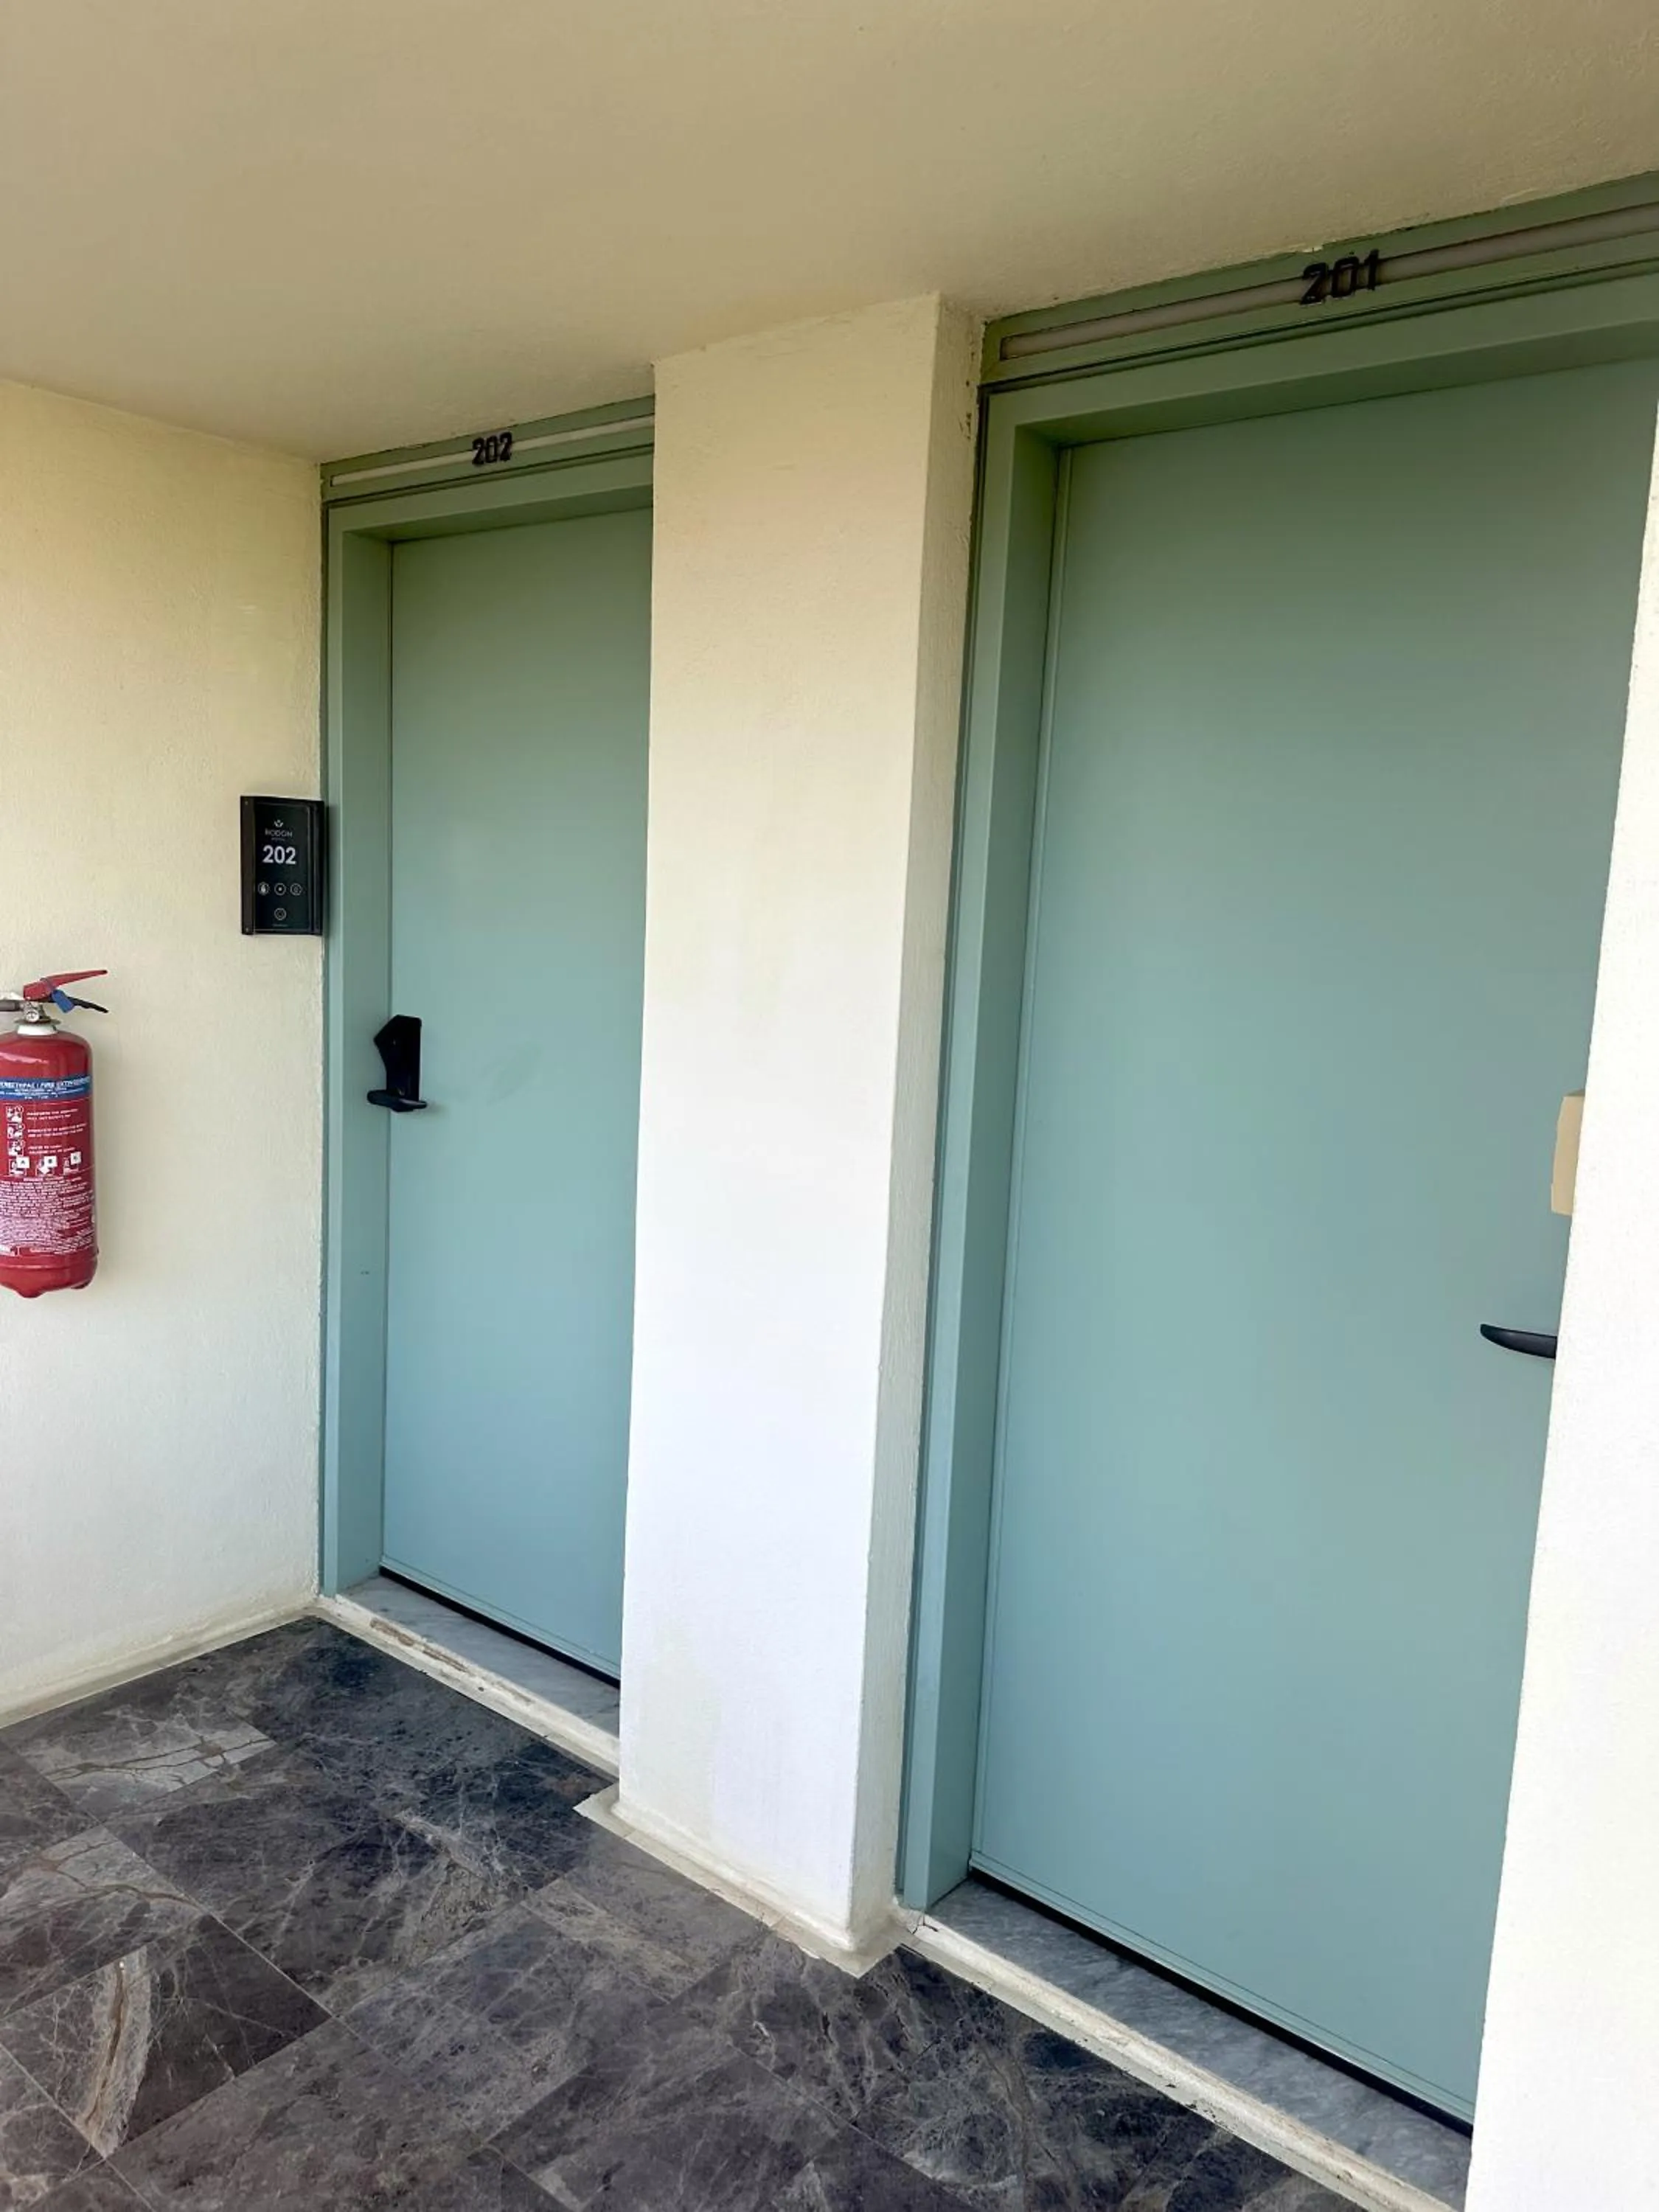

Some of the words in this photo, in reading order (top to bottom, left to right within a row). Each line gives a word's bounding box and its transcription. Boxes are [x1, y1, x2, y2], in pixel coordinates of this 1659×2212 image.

[1300, 249, 1379, 305] 201
[472, 431, 512, 464] 202
[262, 844, 296, 865] 202
